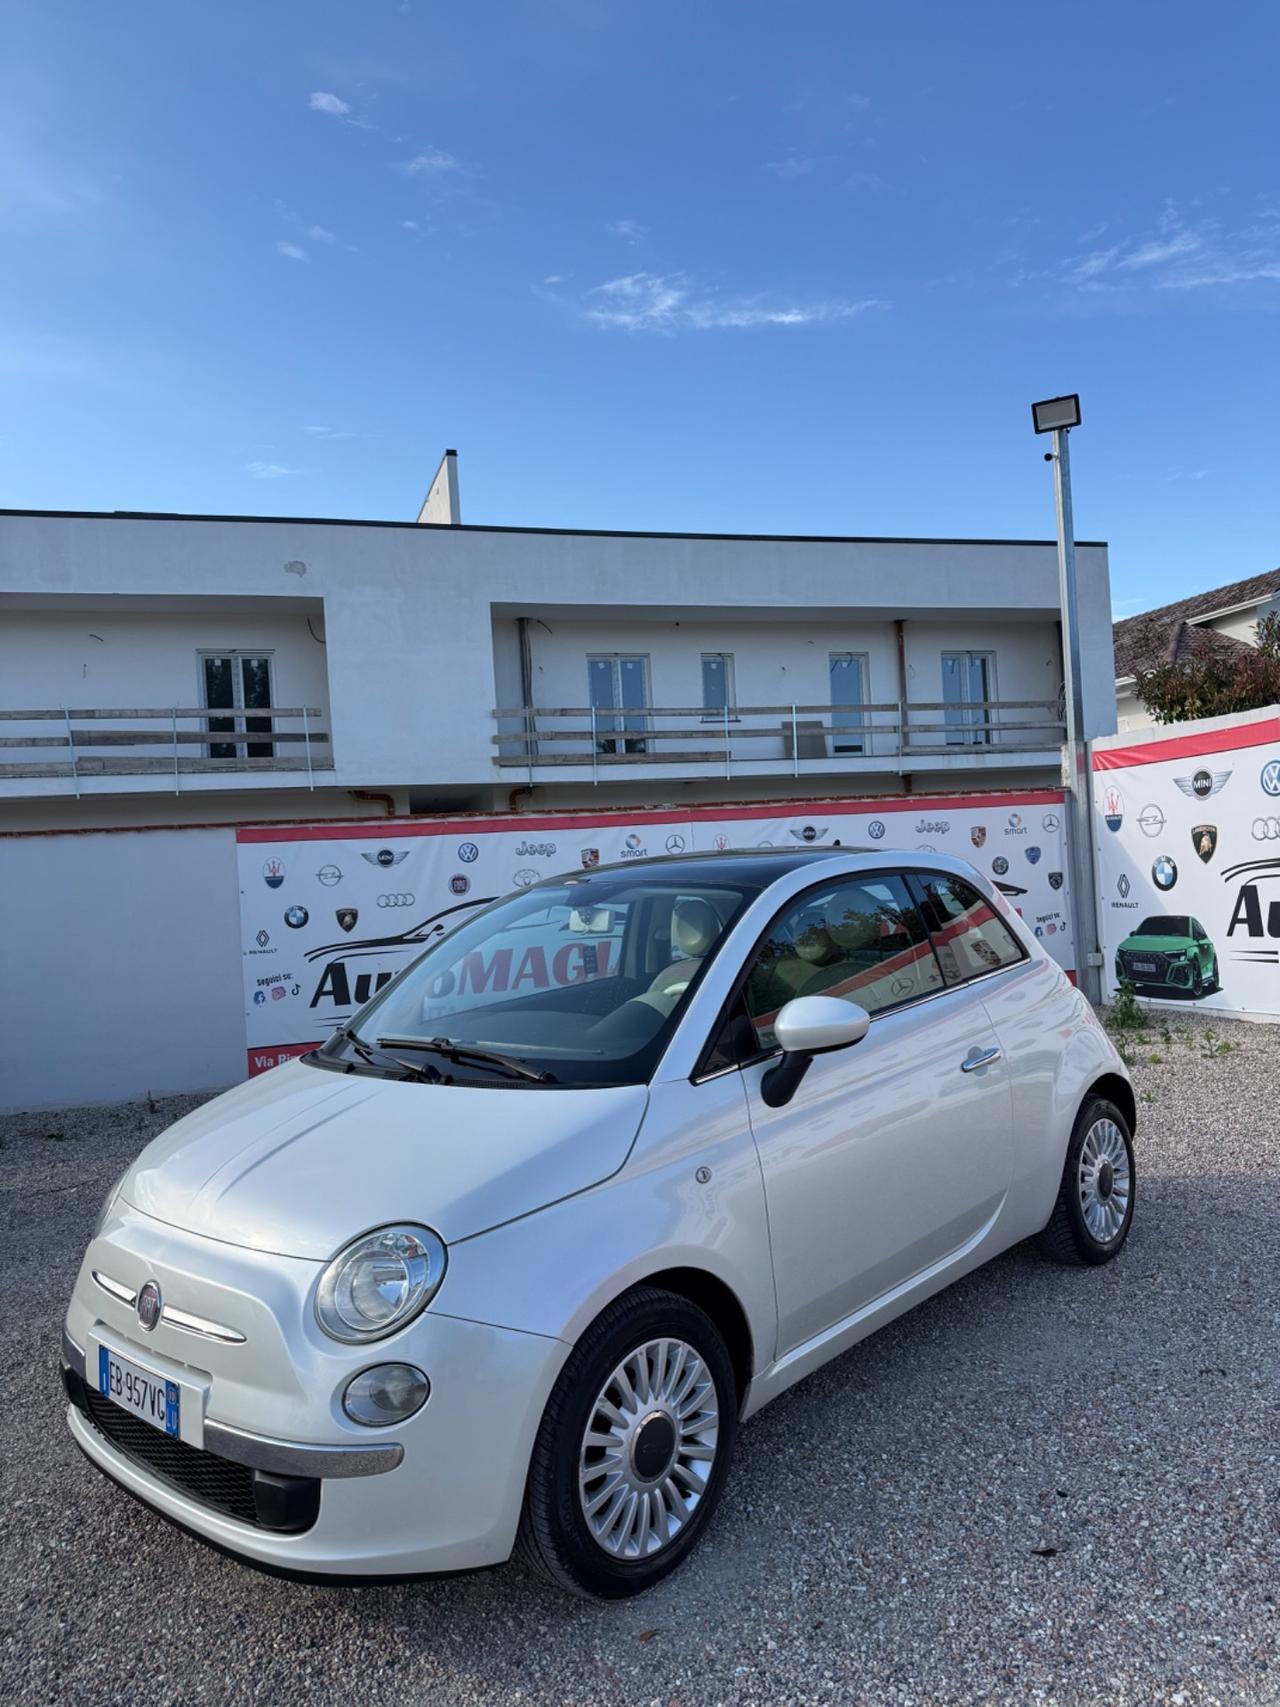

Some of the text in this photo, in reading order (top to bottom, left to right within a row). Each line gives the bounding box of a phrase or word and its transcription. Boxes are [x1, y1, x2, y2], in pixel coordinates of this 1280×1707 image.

[1193, 778, 1212, 789] MINI
[915, 820, 950, 834] Jeep
[1004, 827, 1028, 836] smart
[515, 841, 557, 857] Jeep
[620, 848, 648, 858] smart
[254, 1056, 273, 1068] Via
[110, 1361, 123, 1396] EB
[126, 1372, 166, 1422] 957VG
